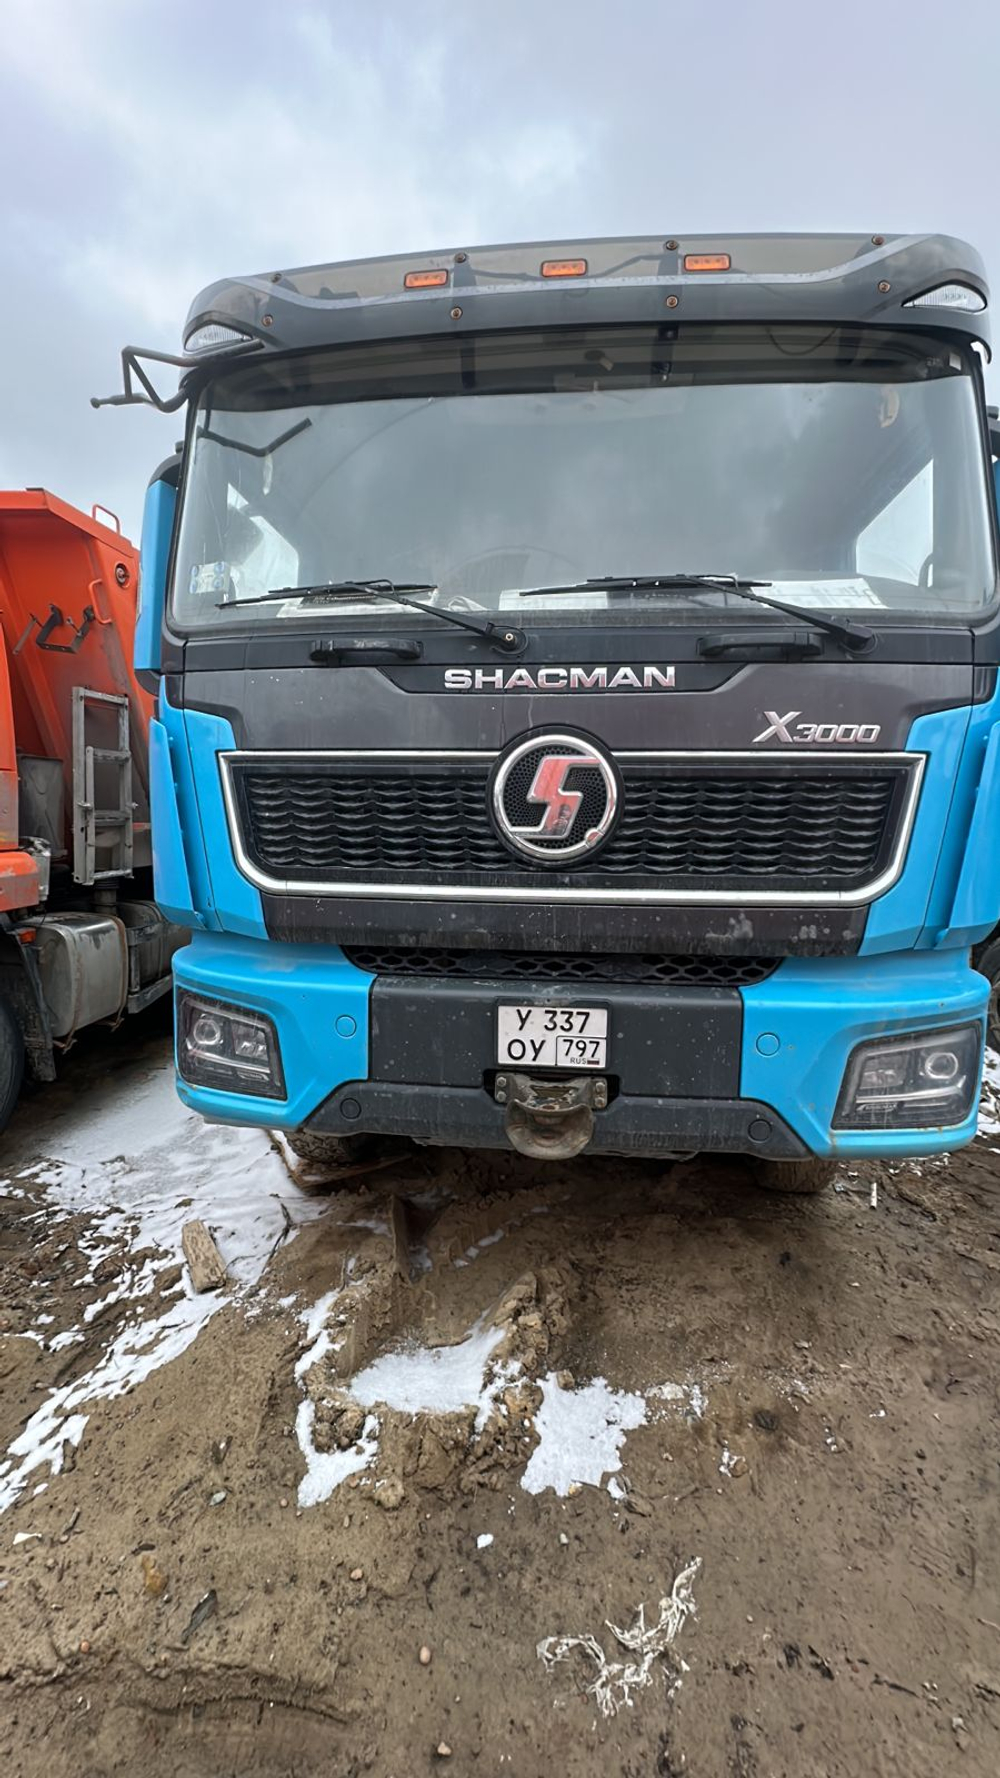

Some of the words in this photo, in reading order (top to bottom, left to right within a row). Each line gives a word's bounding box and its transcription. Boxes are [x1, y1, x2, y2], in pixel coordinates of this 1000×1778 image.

[444, 666, 676, 689] SHACMAN
[752, 711, 881, 743] X3000
[544, 1010, 590, 1033] 337
[563, 1039, 600, 1058] 797
